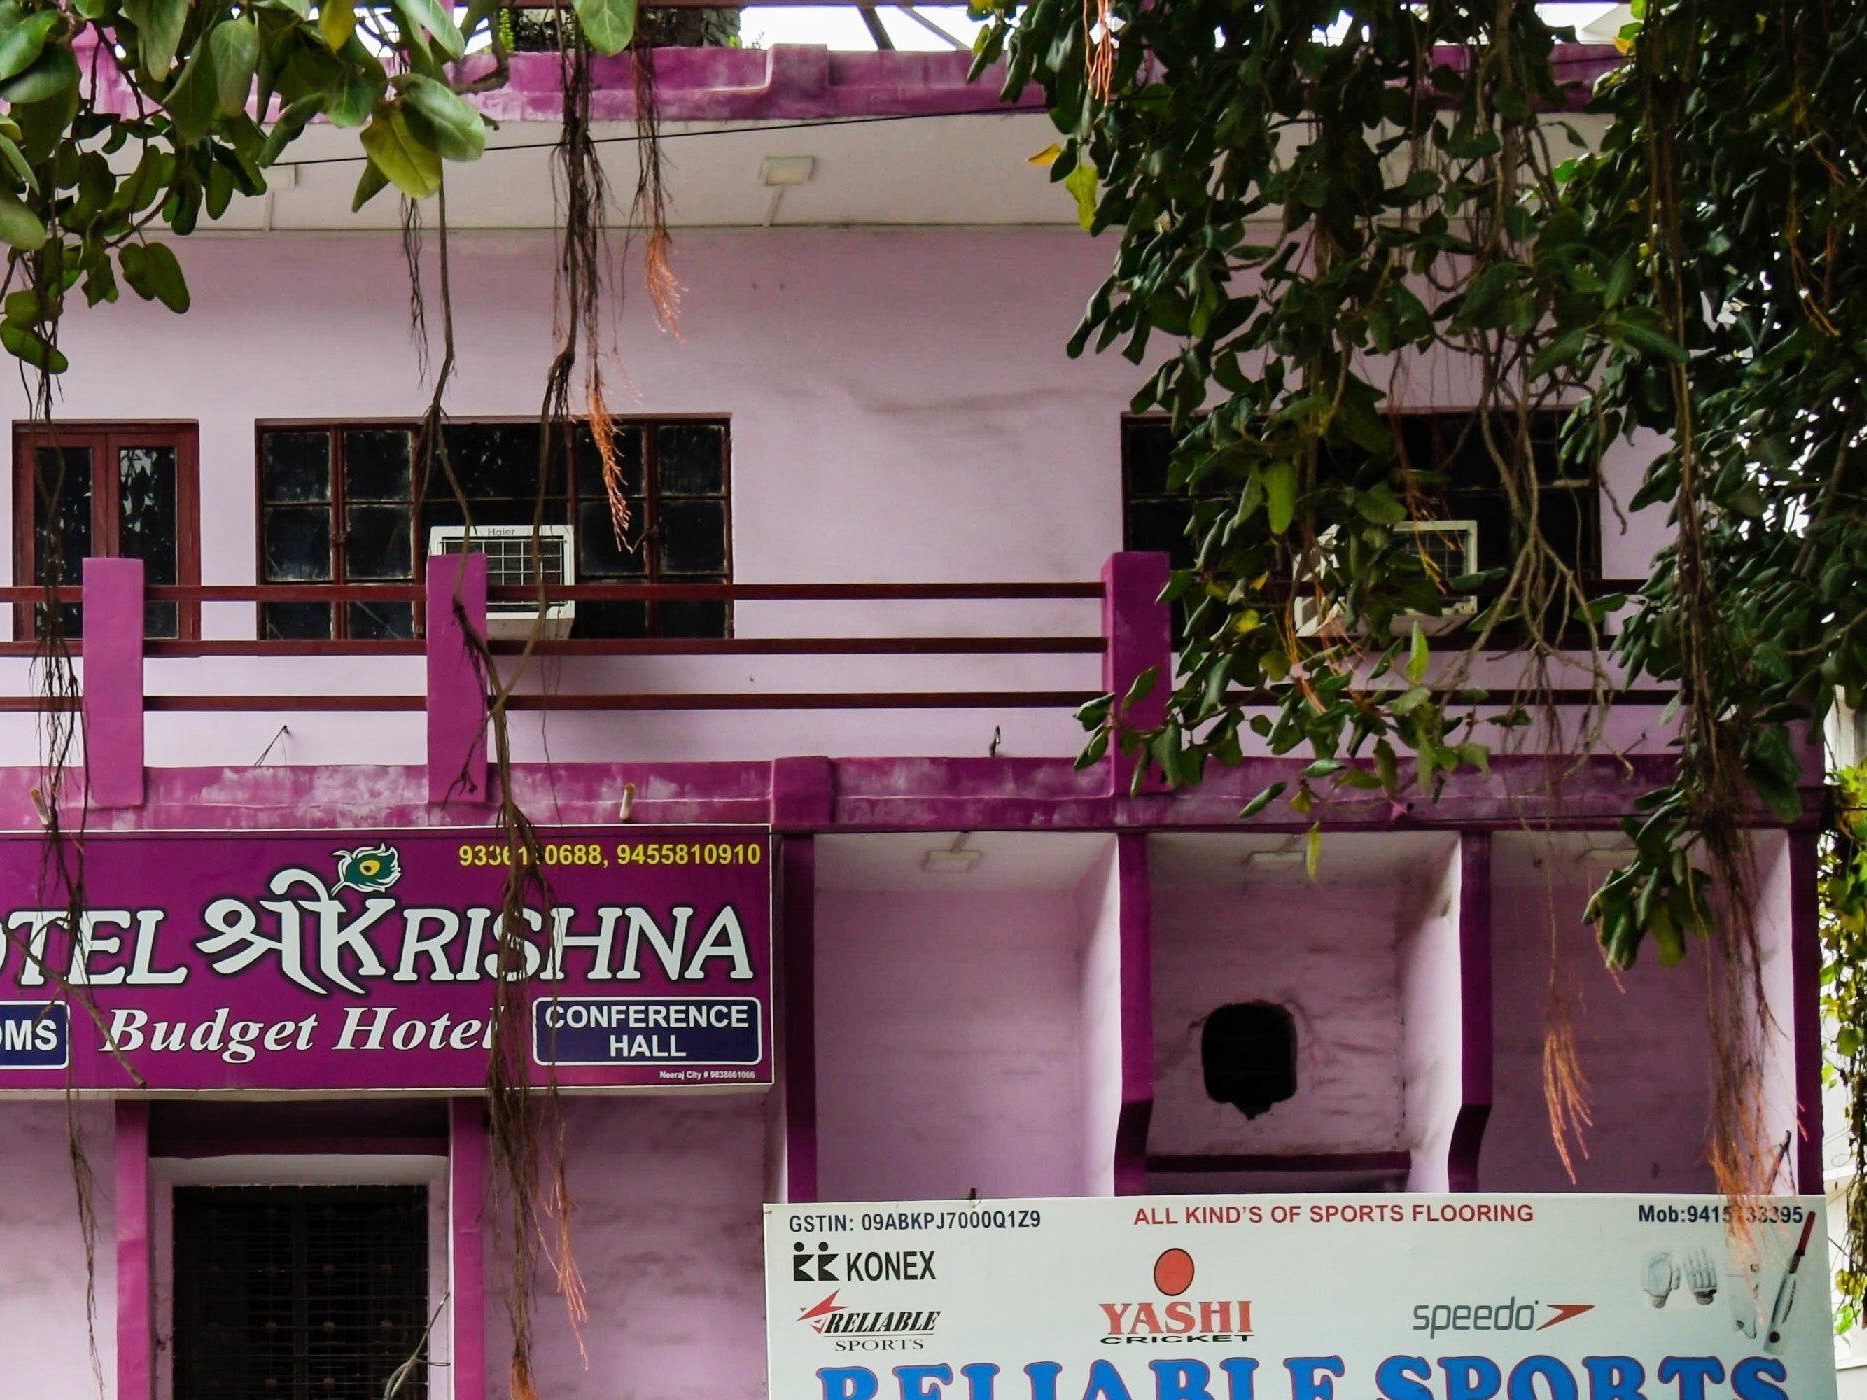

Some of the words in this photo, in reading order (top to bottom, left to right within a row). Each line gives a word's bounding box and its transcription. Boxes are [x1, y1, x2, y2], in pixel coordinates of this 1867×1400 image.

[459, 844, 609, 868] 933610688,
[616, 843, 761, 865] 9455810910
[324, 897, 754, 983] KRISHNA
[545, 1005, 749, 1029] CONFERENCE
[98, 1008, 317, 1064] Budget
[609, 1034, 687, 1058] HALL
[789, 1214, 855, 1234] GSTIN:
[861, 1210, 1042, 1231] 09ABKPJ7000Q1Z9
[1134, 1207, 1179, 1226] ALL
[1184, 1205, 1265, 1225] KIND'S
[1270, 1206, 1302, 1225] OF
[1308, 1205, 1405, 1223] SPORTS
[1411, 1204, 1534, 1223] FLOORING
[845, 1251, 937, 1283] KONEX
[824, 1310, 941, 1334] RELIABLE
[1099, 1301, 1254, 1336] YASHI
[1412, 1296, 1536, 1340] speedo
[834, 1338, 924, 1352] SPORTS
[1099, 1334, 1255, 1345] CRICKET
